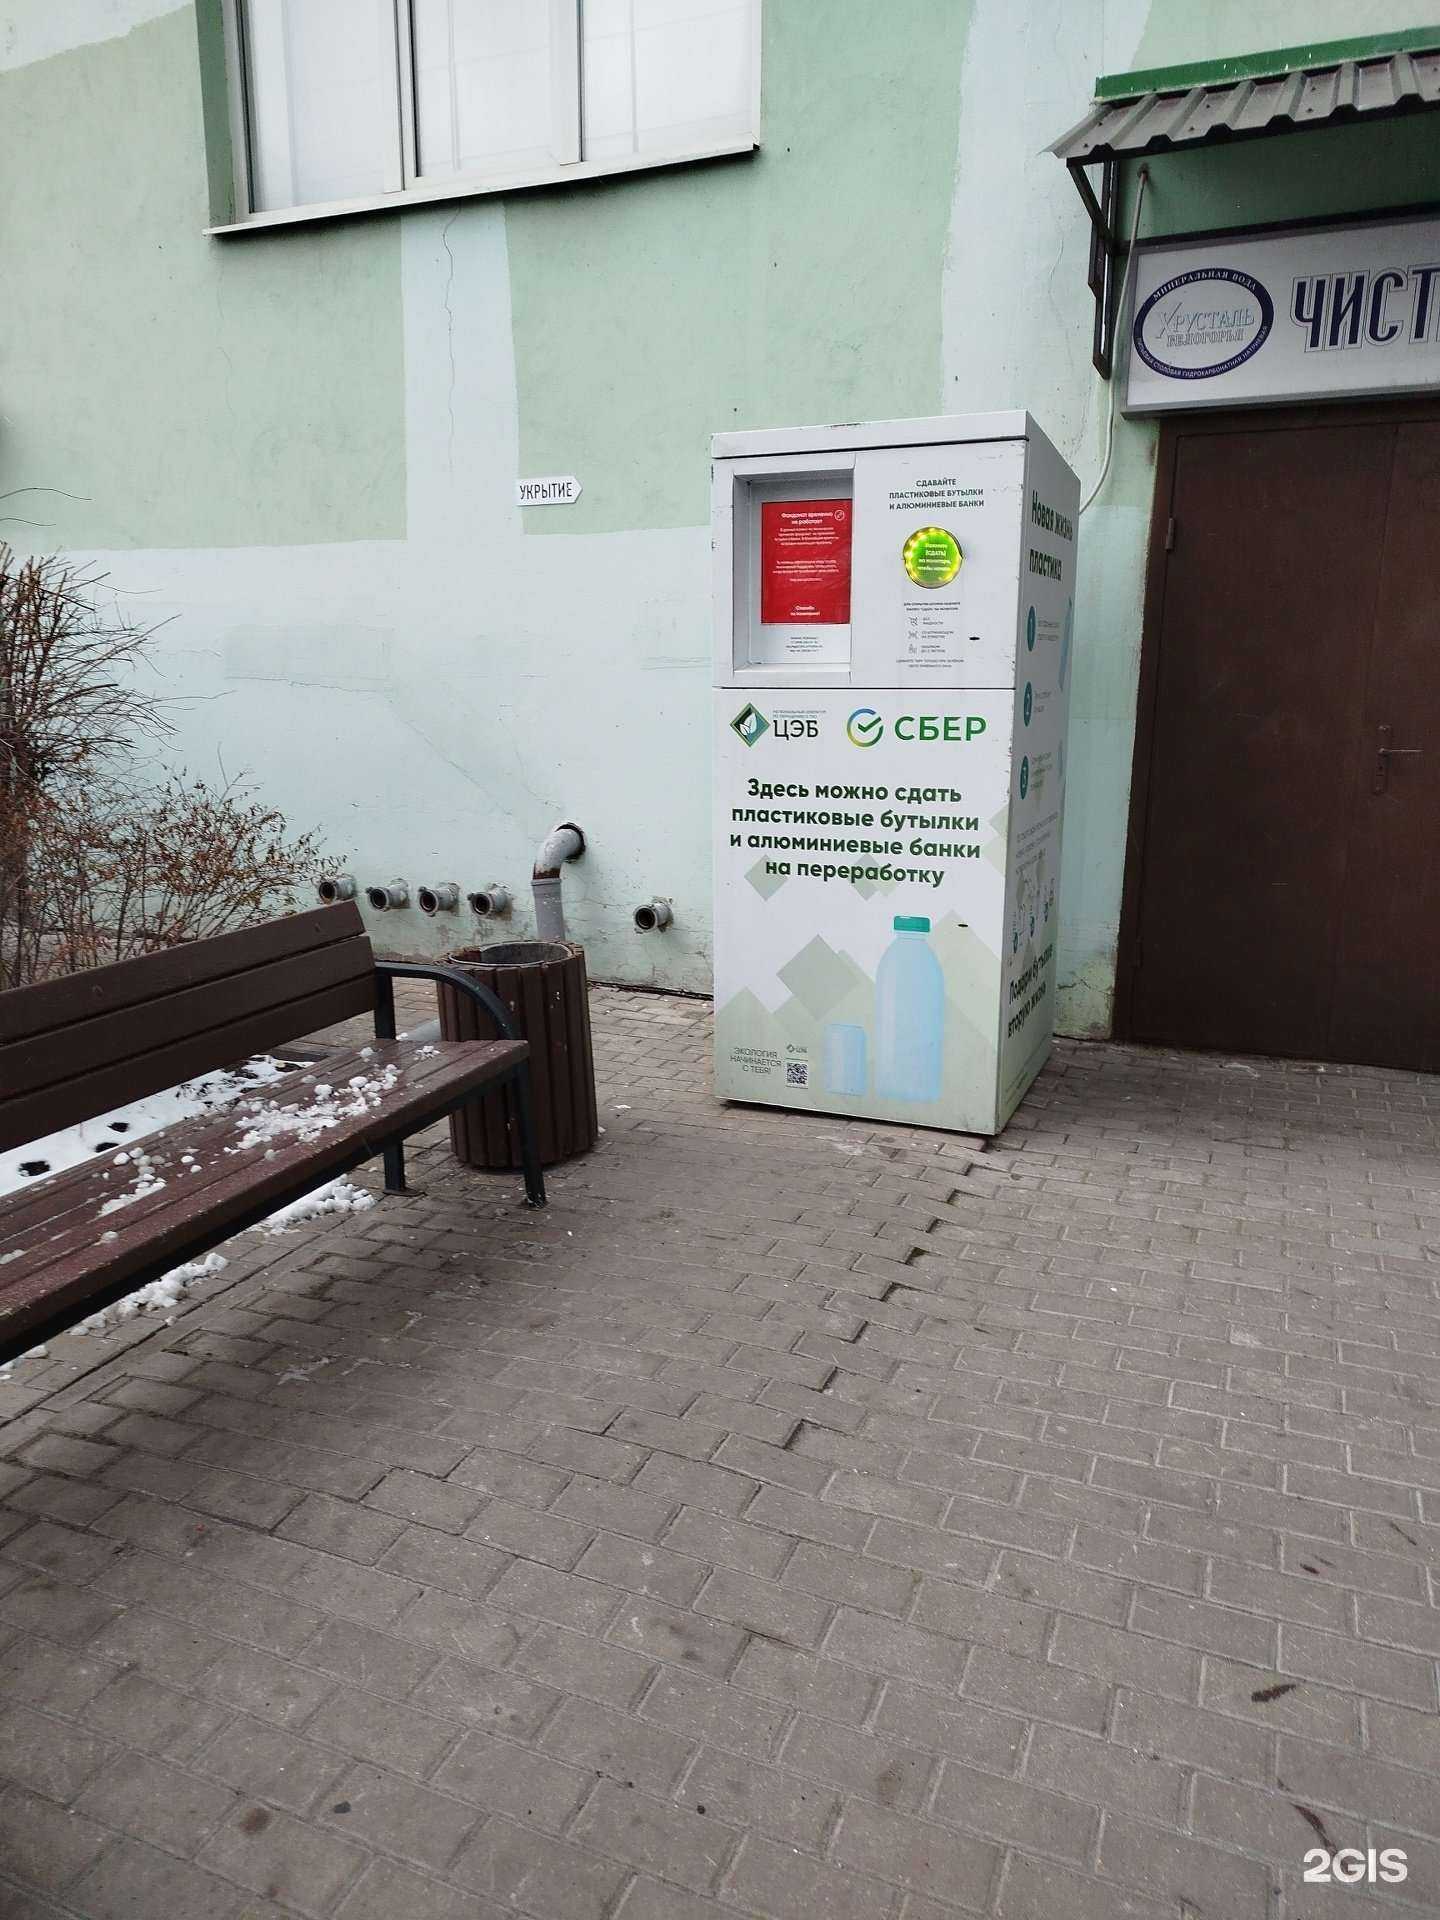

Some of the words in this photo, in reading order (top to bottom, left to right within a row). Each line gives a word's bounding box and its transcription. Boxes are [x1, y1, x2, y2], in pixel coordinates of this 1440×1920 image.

[1153, 270, 1229, 301] МИНЕРАЛЬНАЯ
[1231, 273, 1257, 291] ВОДА
[1291, 264, 1440, 353] ЧИСТ
[519, 482, 573, 500] УКРЫТИЕ
[889, 490, 945, 499] ПЛАСТИКОВЫЕ
[947, 488, 984, 497] БУТЫЛКИ
[915, 477, 957, 488] СДАВАЙТЕ
[896, 500, 957, 510] АЛЮМИНИЕВЫЕ
[958, 499, 985, 508] БАНКИ
[1031, 489, 1054, 532] Новая
[1029, 548, 1062, 581] пластика
[772, 719, 819, 741] ЦЭБ
[894, 715, 987, 741] СБЕР
[747, 778, 809, 799] Здесь
[815, 784, 889, 800] можно
[895, 786, 962, 804] сдать
[731, 807, 874, 827] пластиковые
[880, 809, 979, 832] бутылки
[730, 834, 741, 847] и
[747, 834, 903, 855] алюминиевые
[909, 837, 981, 858] банки
[765, 860, 791, 875] на
[797, 862, 944, 888] переработку
[730, 1055, 782, 1067] НАЧИНАЕТСЯ
[733, 1047, 777, 1058] ЭКОЛОГИЯ
[742, 1064, 749, 1072] С
